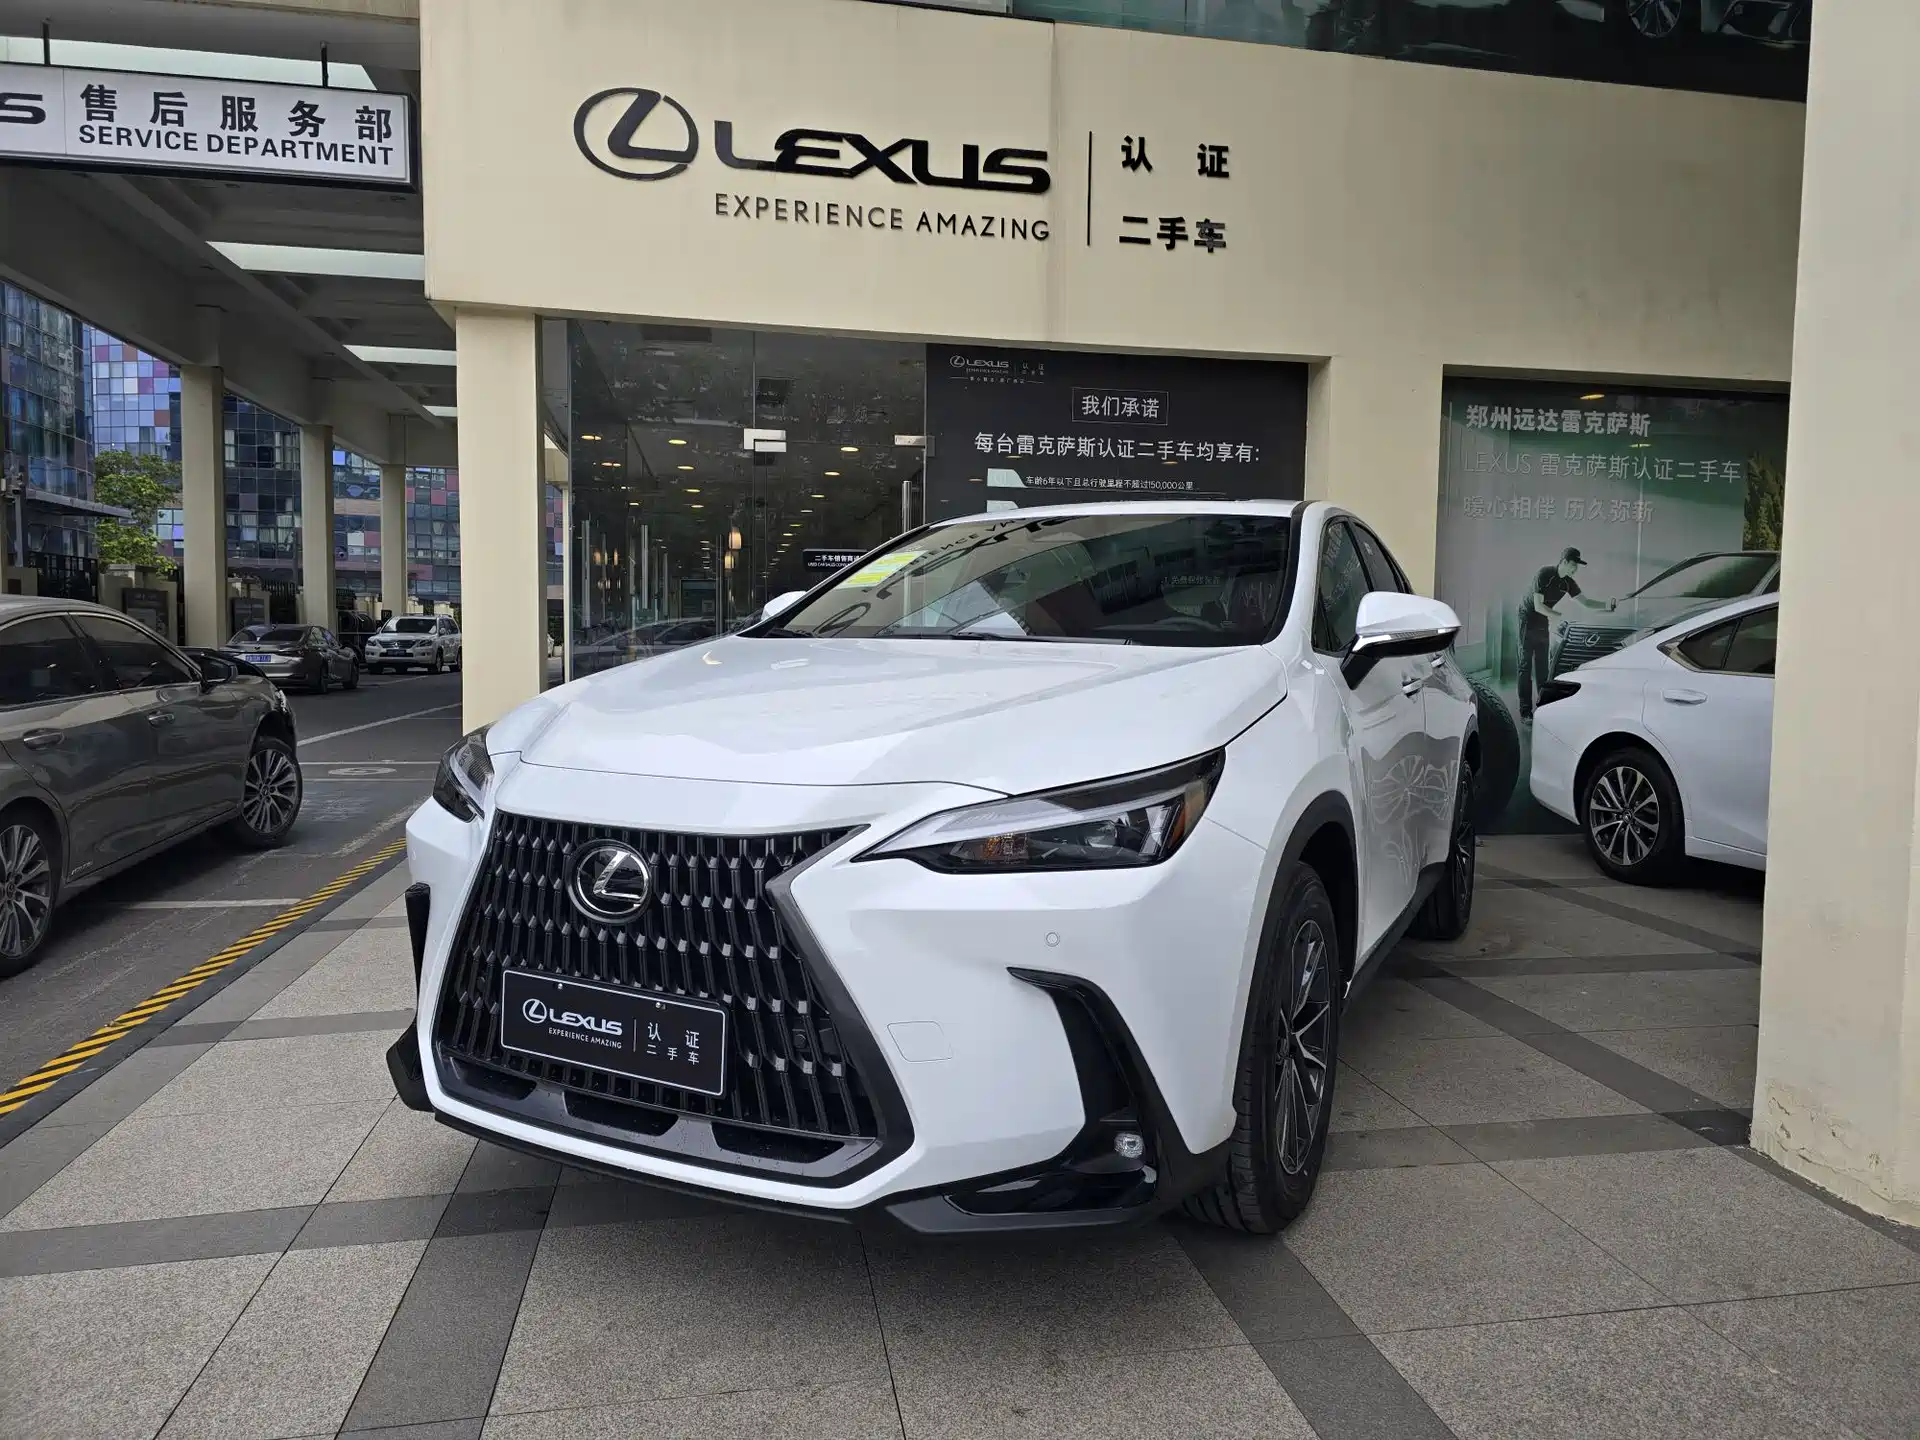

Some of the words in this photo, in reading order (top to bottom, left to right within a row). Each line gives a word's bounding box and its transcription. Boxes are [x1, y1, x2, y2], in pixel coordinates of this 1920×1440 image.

[80, 83, 392, 143] 售后服务部
[79, 124, 198, 152] SERVICE
[206, 133, 394, 166] DEPARTMENT
[714, 120, 1051, 195] LEXUS
[1121, 135, 1230, 180] 认证
[715, 192, 903, 231] EXPERIENCE
[916, 210, 1051, 242] AMAZING
[1118, 216, 1228, 254] 二手车
[966, 359, 1009, 368] LEXUS
[1081, 395, 1160, 419] 我们承诺
[1466, 404, 1651, 437] 郑州远达雷克萨斯
[1463, 452, 1532, 474] LEXUS
[1540, 453, 1742, 483] 雷克萨斯认证二手车
[1463, 495, 1557, 522] 暖心相伴
[1564, 498, 1655, 524] 历久弥新
[549, 1008, 623, 1036] LEXUS
[648, 1022, 700, 1049] 认证
[548, 1027, 589, 1043] EXPERIENCE
[590, 1036, 622, 1049] AMAZING
[647, 1043, 700, 1066] 二手车
